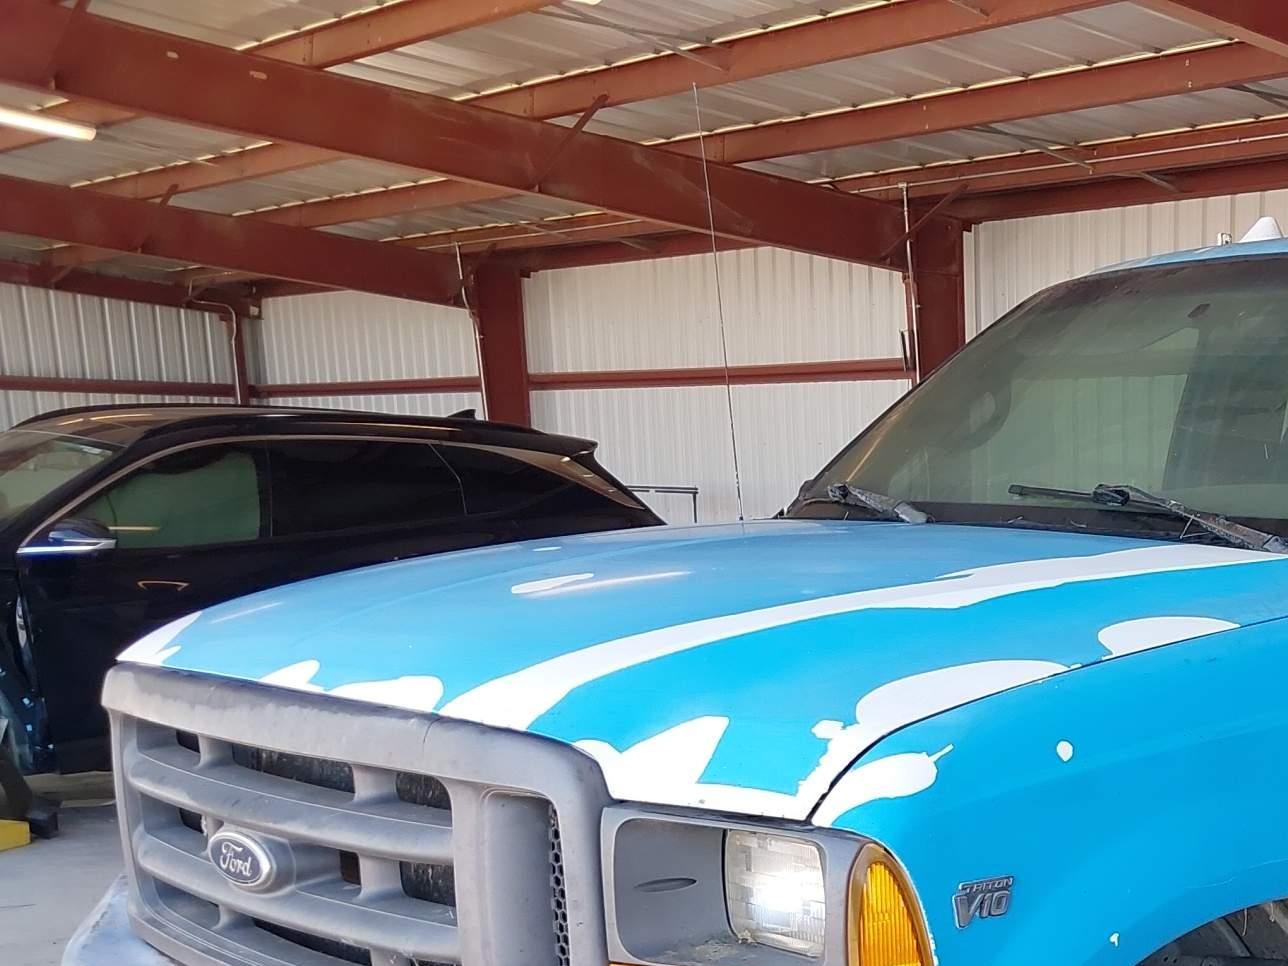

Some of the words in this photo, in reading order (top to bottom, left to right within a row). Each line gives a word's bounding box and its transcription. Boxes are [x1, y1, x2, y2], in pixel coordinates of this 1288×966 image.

[220, 841, 253, 877] Ford
[962, 877, 1013, 893] TRITON
[953, 890, 1011, 928] V10
